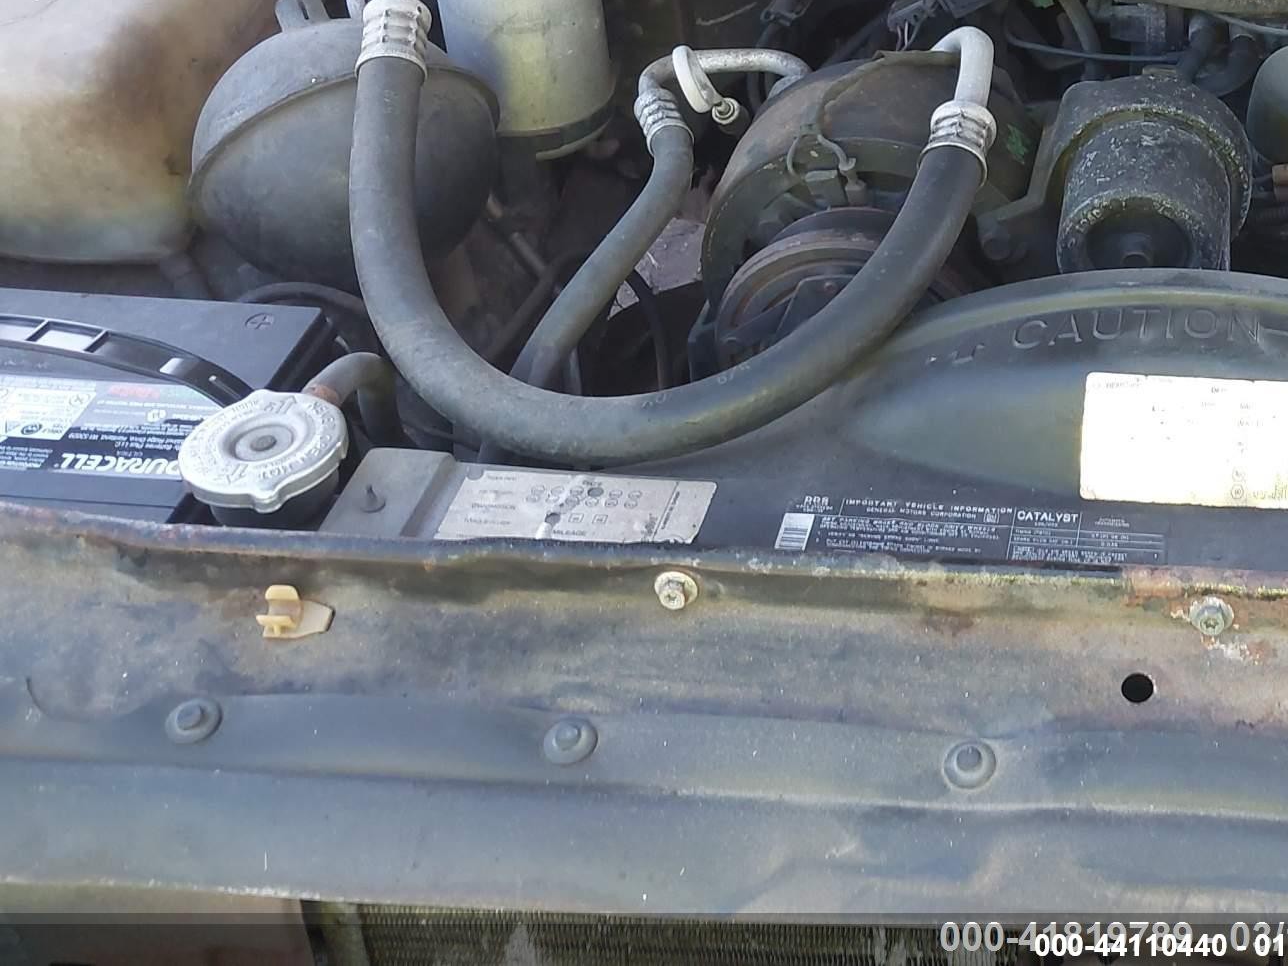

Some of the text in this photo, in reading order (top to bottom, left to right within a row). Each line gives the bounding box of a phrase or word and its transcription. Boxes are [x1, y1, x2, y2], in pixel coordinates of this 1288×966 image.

[61, 452, 180, 476] DURACELL
[905, 502, 945, 511] VEHICLE
[950, 505, 1013, 514] INFORMATION
[1016, 510, 1079, 523] CATALYST
